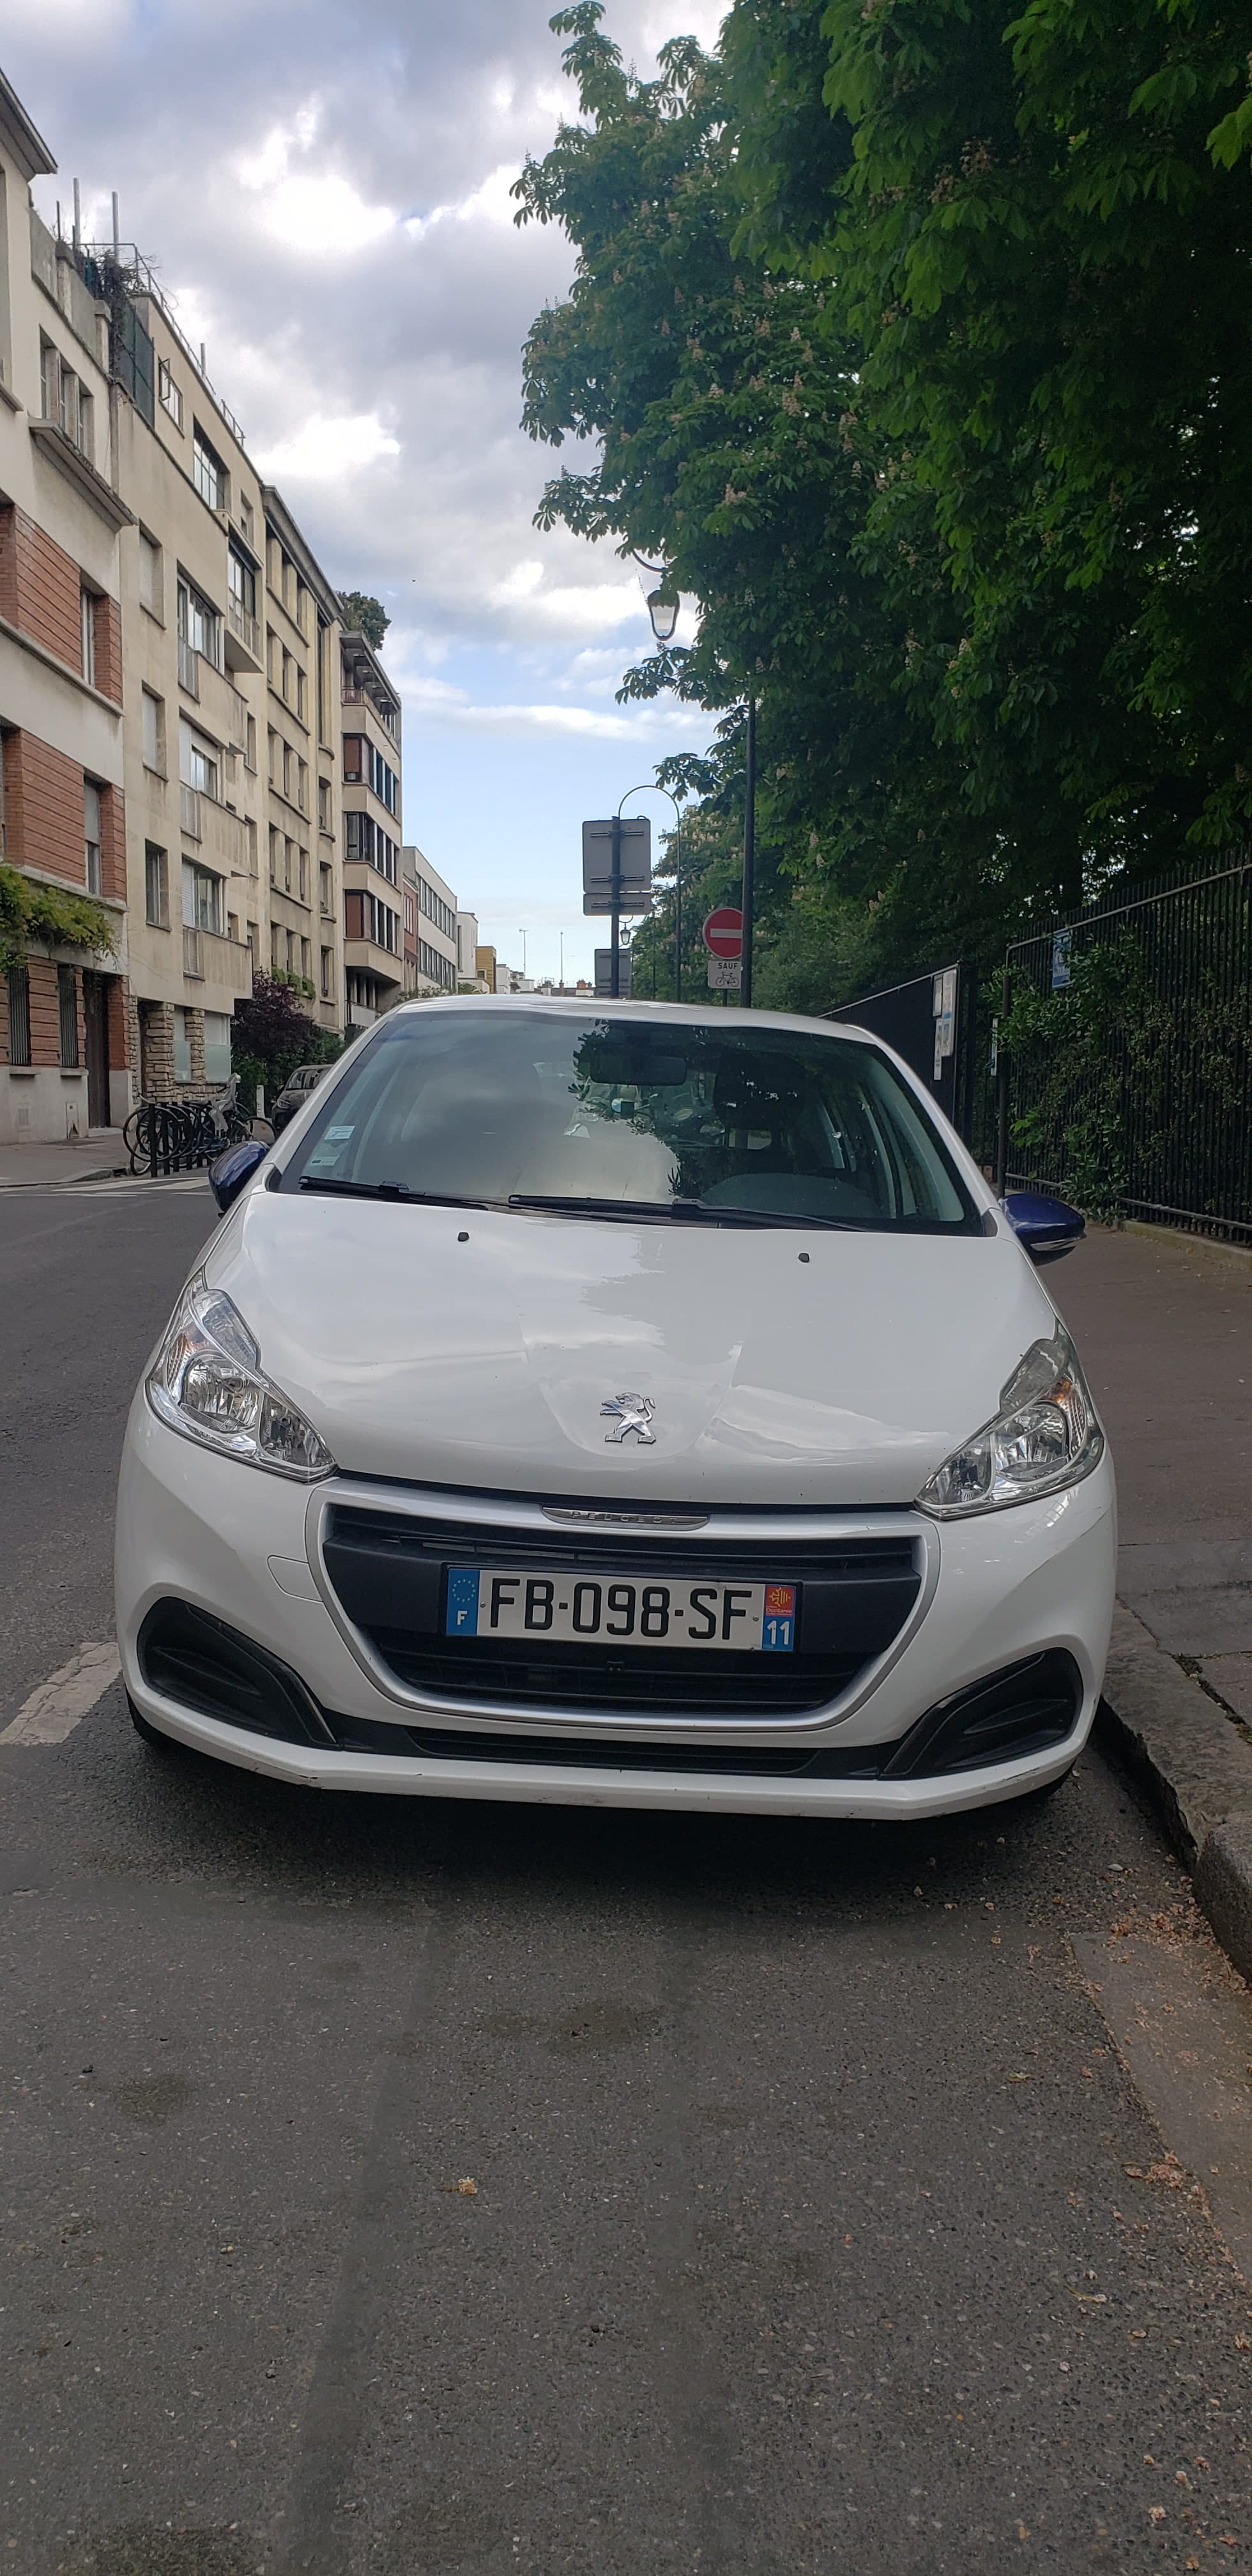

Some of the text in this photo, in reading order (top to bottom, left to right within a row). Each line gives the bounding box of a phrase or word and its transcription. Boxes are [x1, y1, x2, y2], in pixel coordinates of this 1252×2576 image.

[571, 1510, 678, 1524] PEUGEOT
[457, 1610, 468, 1625] F
[491, 1578, 752, 1640] FB-098-SF
[767, 1620, 790, 1645] 11
